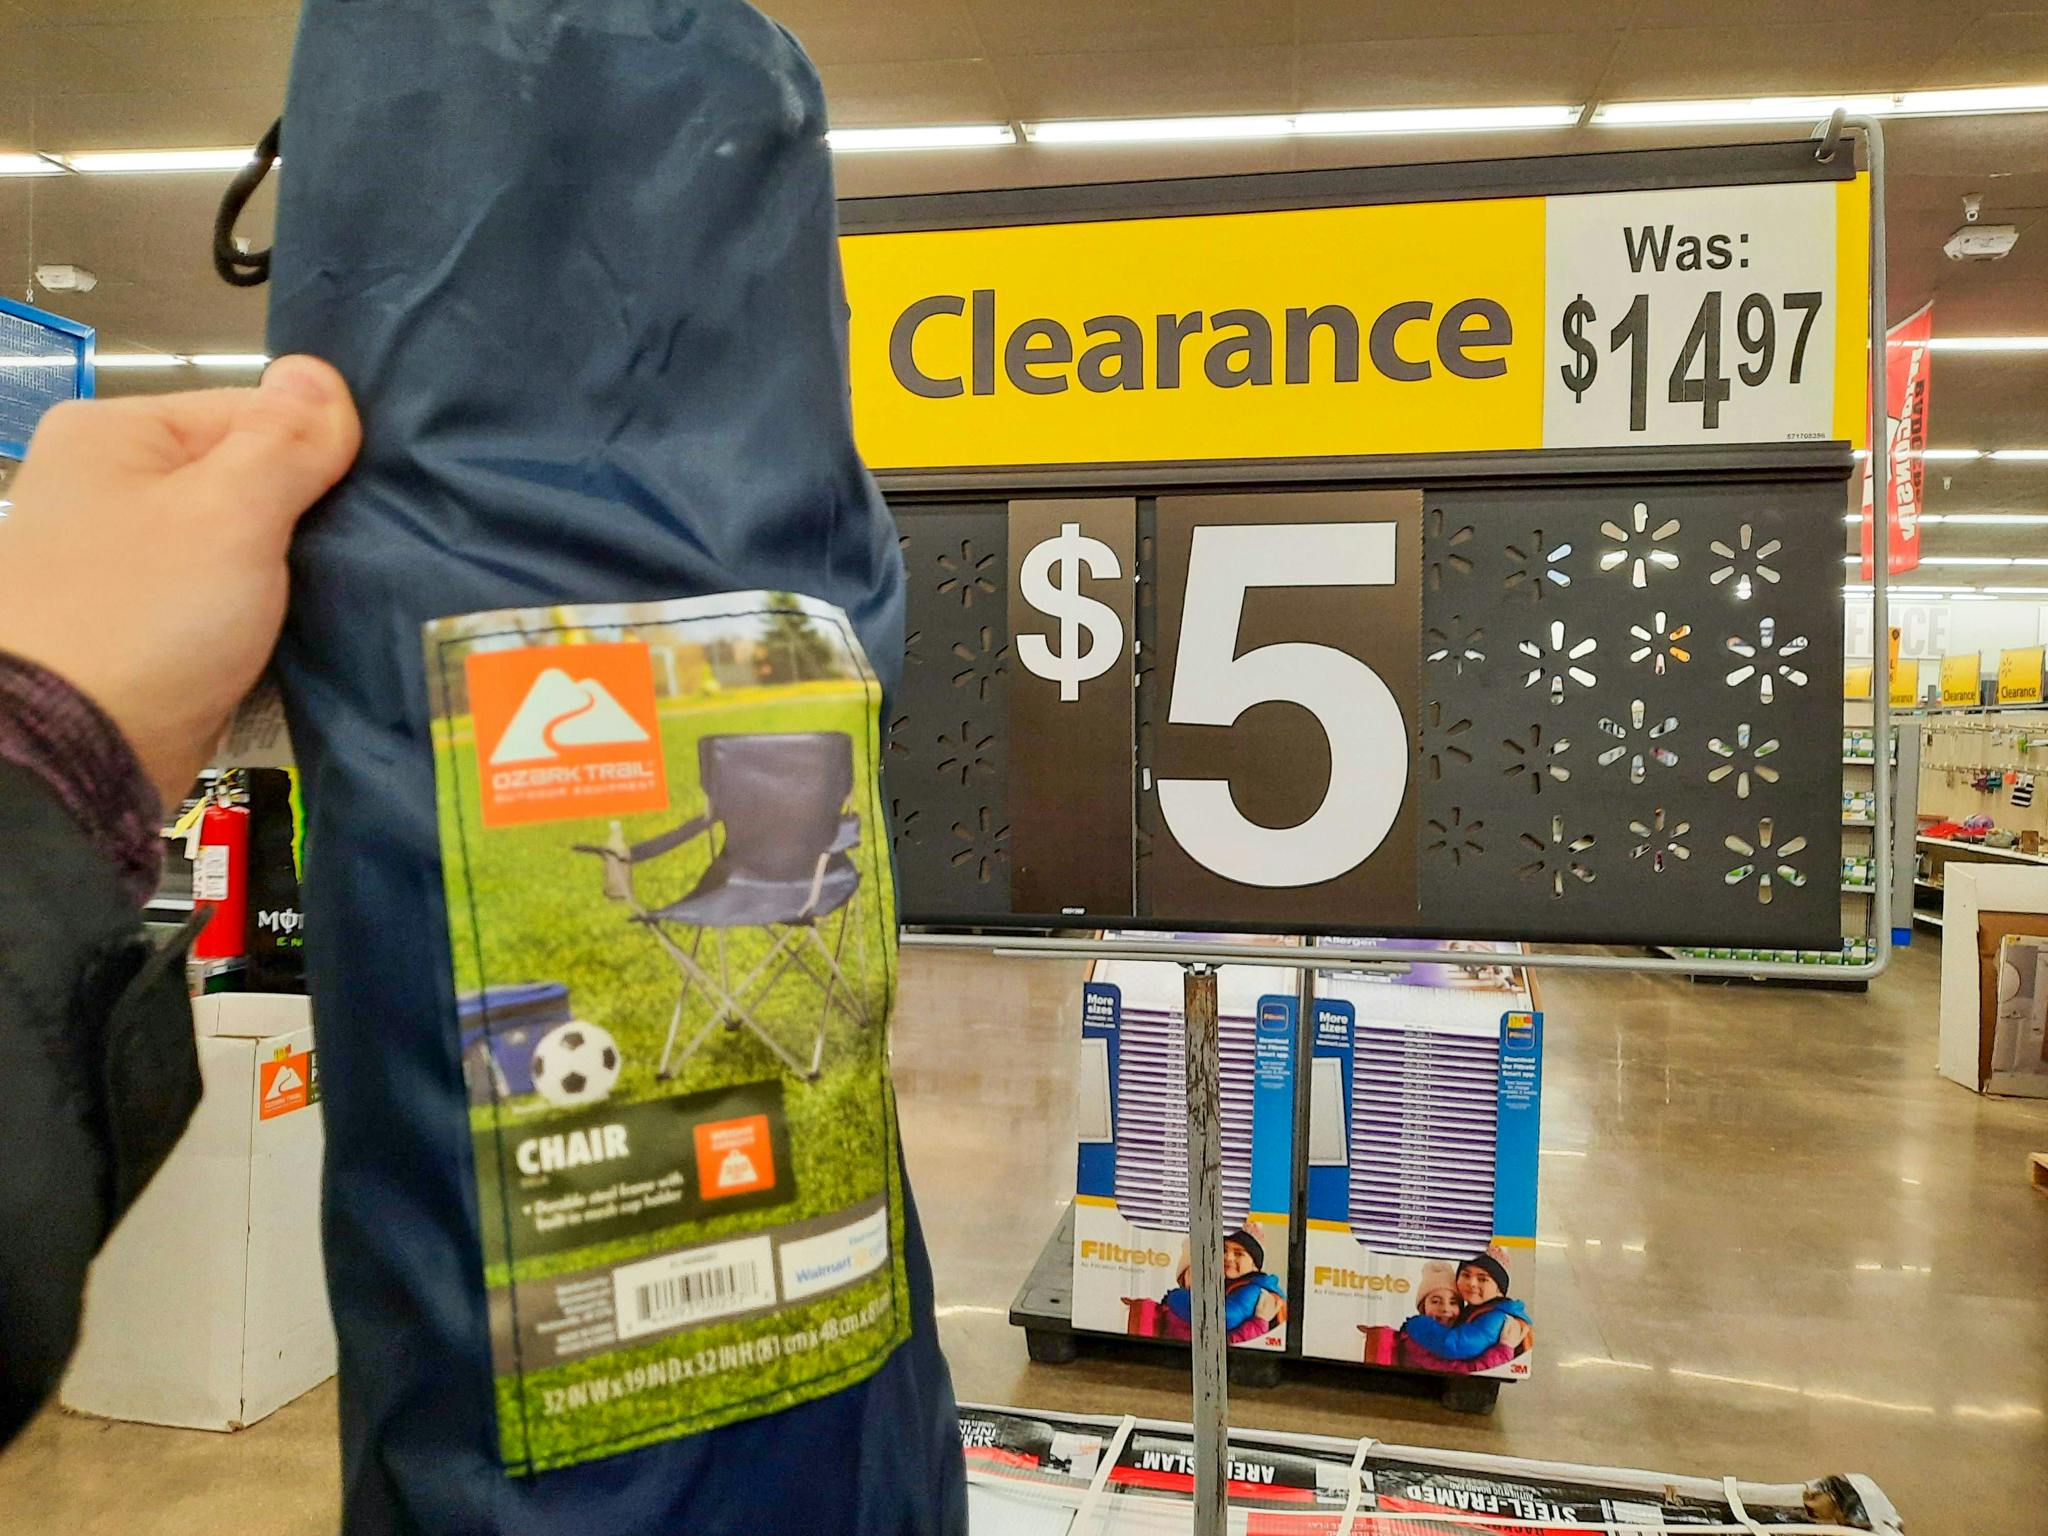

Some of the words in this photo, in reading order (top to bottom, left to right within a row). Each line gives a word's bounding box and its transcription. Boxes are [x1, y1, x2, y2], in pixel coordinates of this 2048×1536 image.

[1623, 224, 1749, 273] Was:
[889, 289, 1514, 400] Clearance
[1943, 688, 1976, 701] Clearance
[2001, 685, 2037, 699] Clearance
[492, 766, 581, 790] OZARK
[584, 760, 656, 781] TRAIL
[1087, 993, 1115, 1007] More
[1088, 1003, 1114, 1016] sizes
[1319, 1011, 1349, 1025] More
[1319, 1021, 1348, 1034] sizes
[515, 1123, 630, 1175] CHAIR
[1080, 1240, 1171, 1268] Filtrete
[1313, 1266, 1411, 1294] Filtrete
[1264, 1336, 1282, 1347] 3M
[1510, 1364, 1528, 1375] 3M
[1227, 1461, 1276, 1485] ARE
[1406, 1484, 1578, 1524] STEEL-FRAMED
